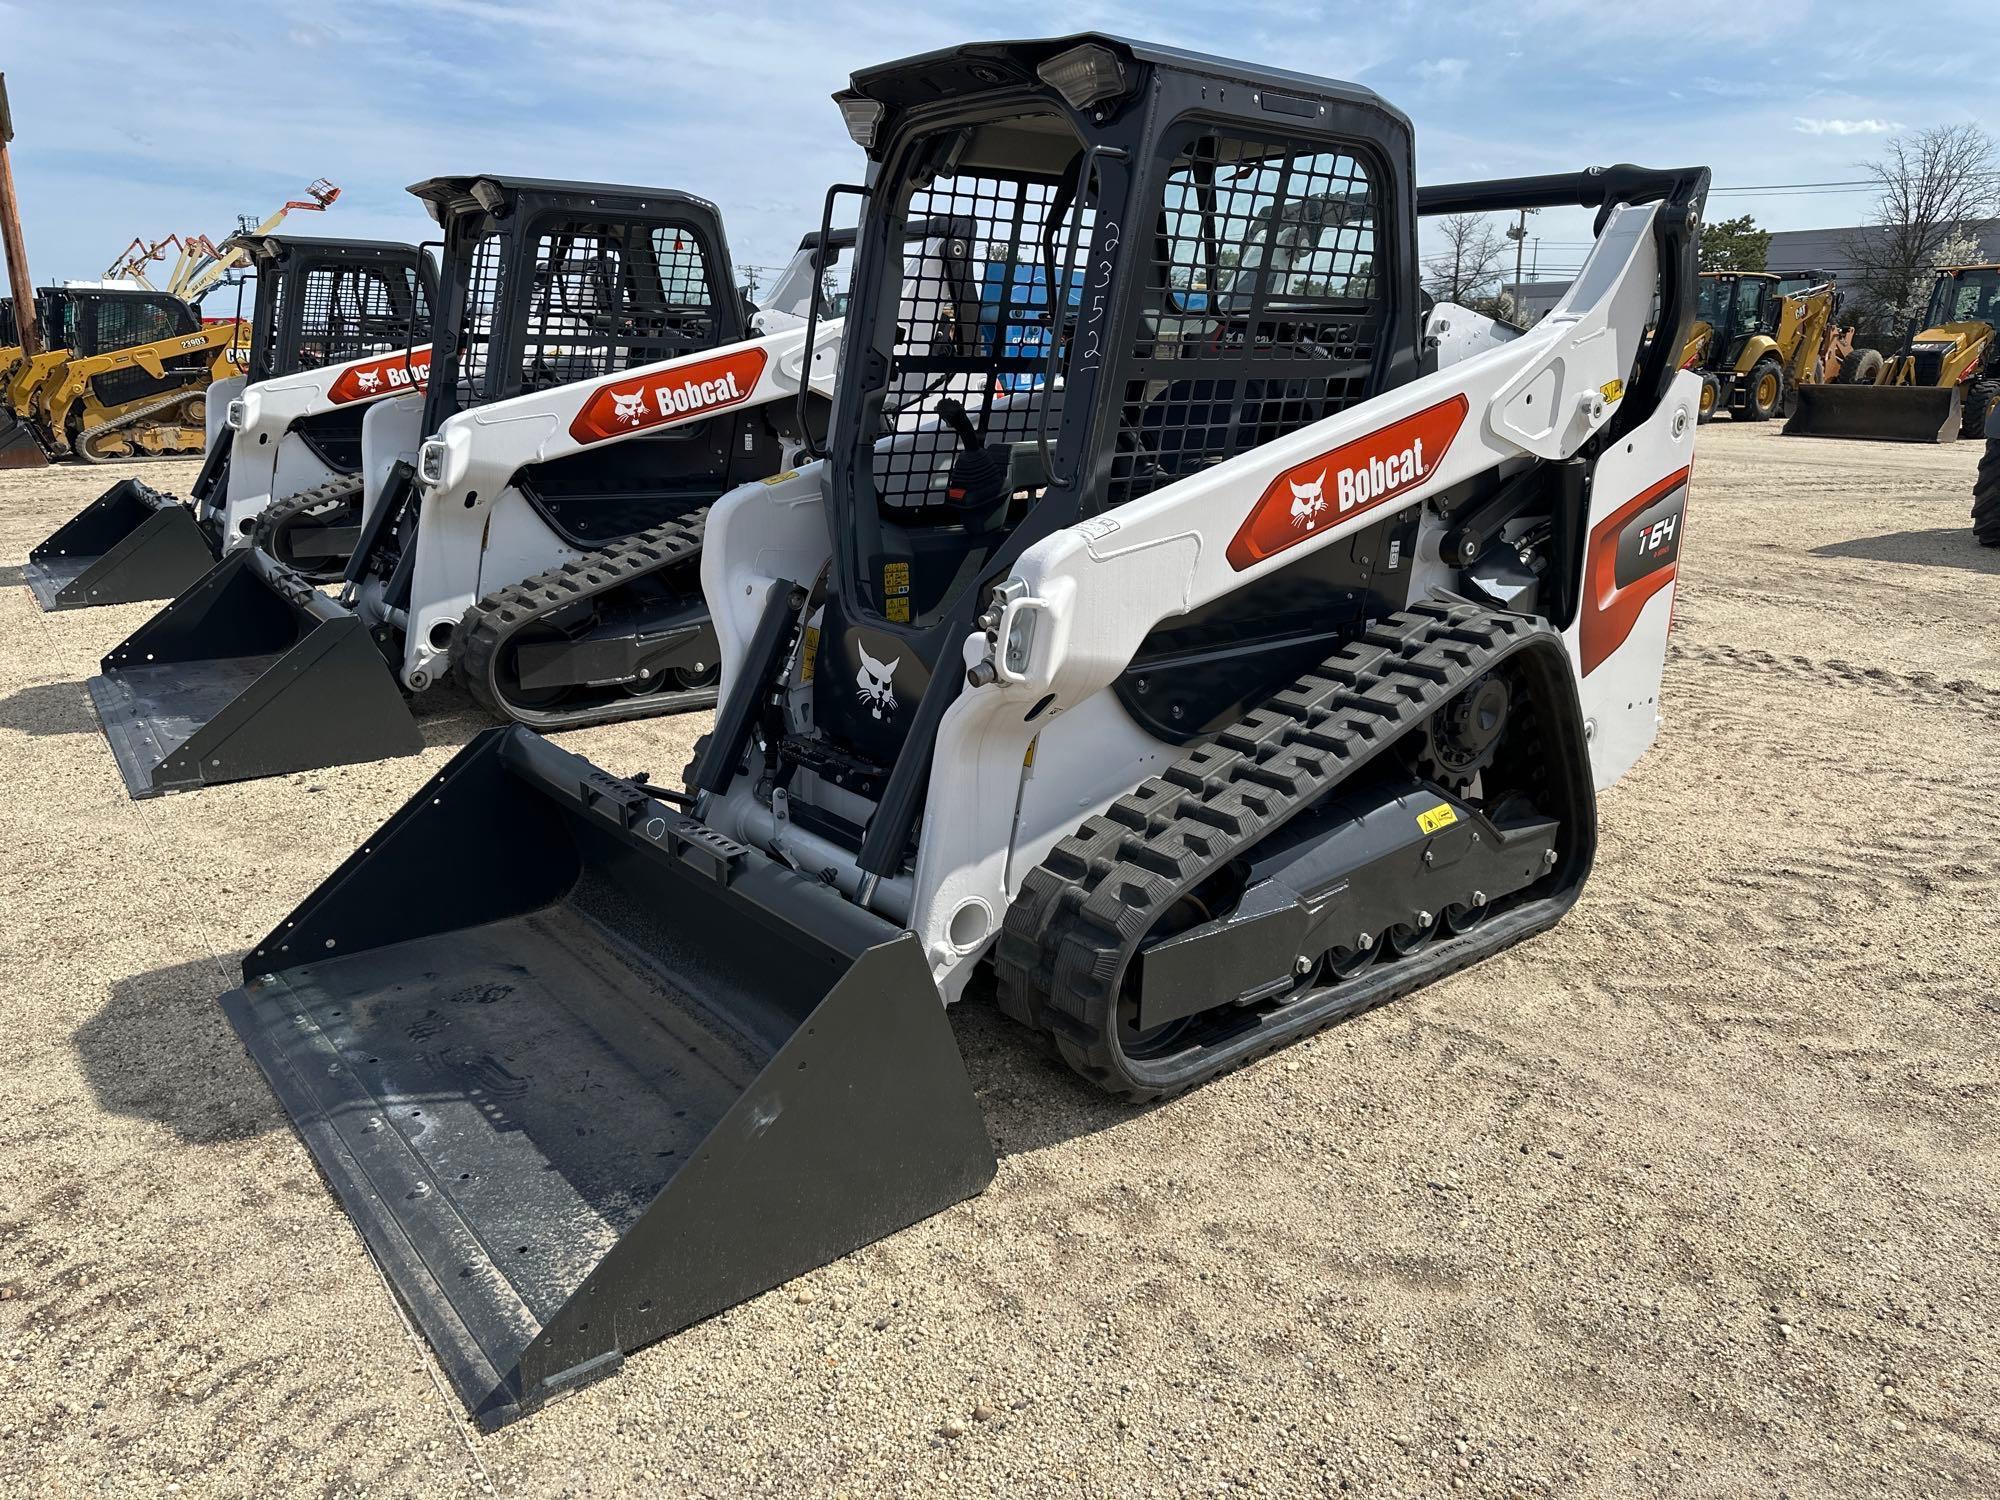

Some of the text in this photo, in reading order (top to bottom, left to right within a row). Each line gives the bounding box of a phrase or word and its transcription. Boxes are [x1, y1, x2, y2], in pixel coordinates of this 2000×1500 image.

[181, 336, 206, 349] 239D3
[386, 362, 431, 387] Bobc
[655, 371, 740, 417] Bobcat
[1337, 437, 1424, 513] Bobcat
[1639, 513, 1678, 556] T64
